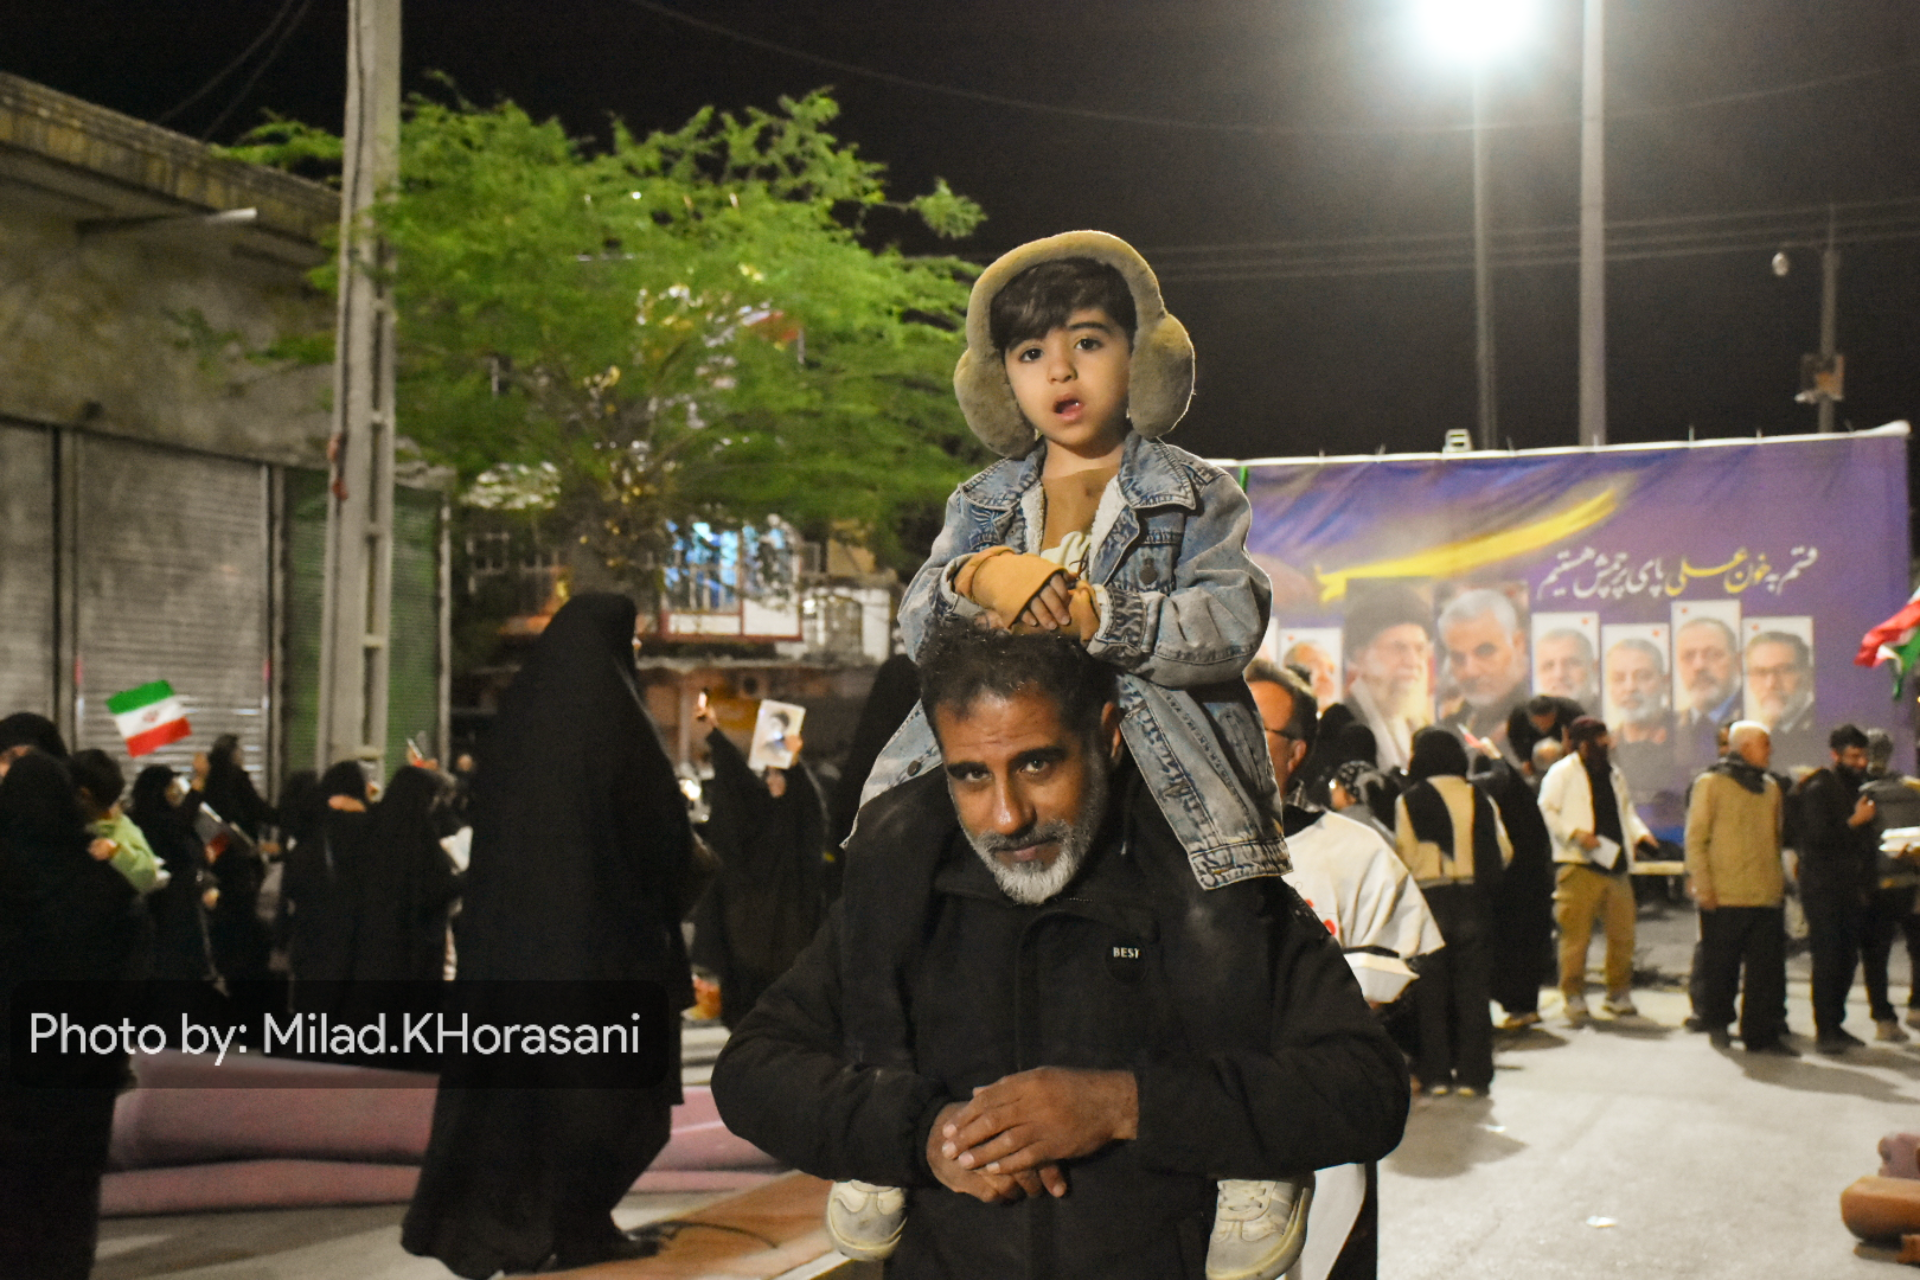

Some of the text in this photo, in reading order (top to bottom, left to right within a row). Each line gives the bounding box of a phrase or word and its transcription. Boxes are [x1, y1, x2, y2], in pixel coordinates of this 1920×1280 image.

[1536, 545, 1597, 601] هستیم
[1572, 551, 1629, 599] پرچمش
[1625, 556, 1664, 598] پای
[1664, 546, 1748, 597] علی
[1723, 552, 1772, 594] خون
[1776, 546, 1818, 596] قسم
[1112, 946, 1141, 959] BEST
